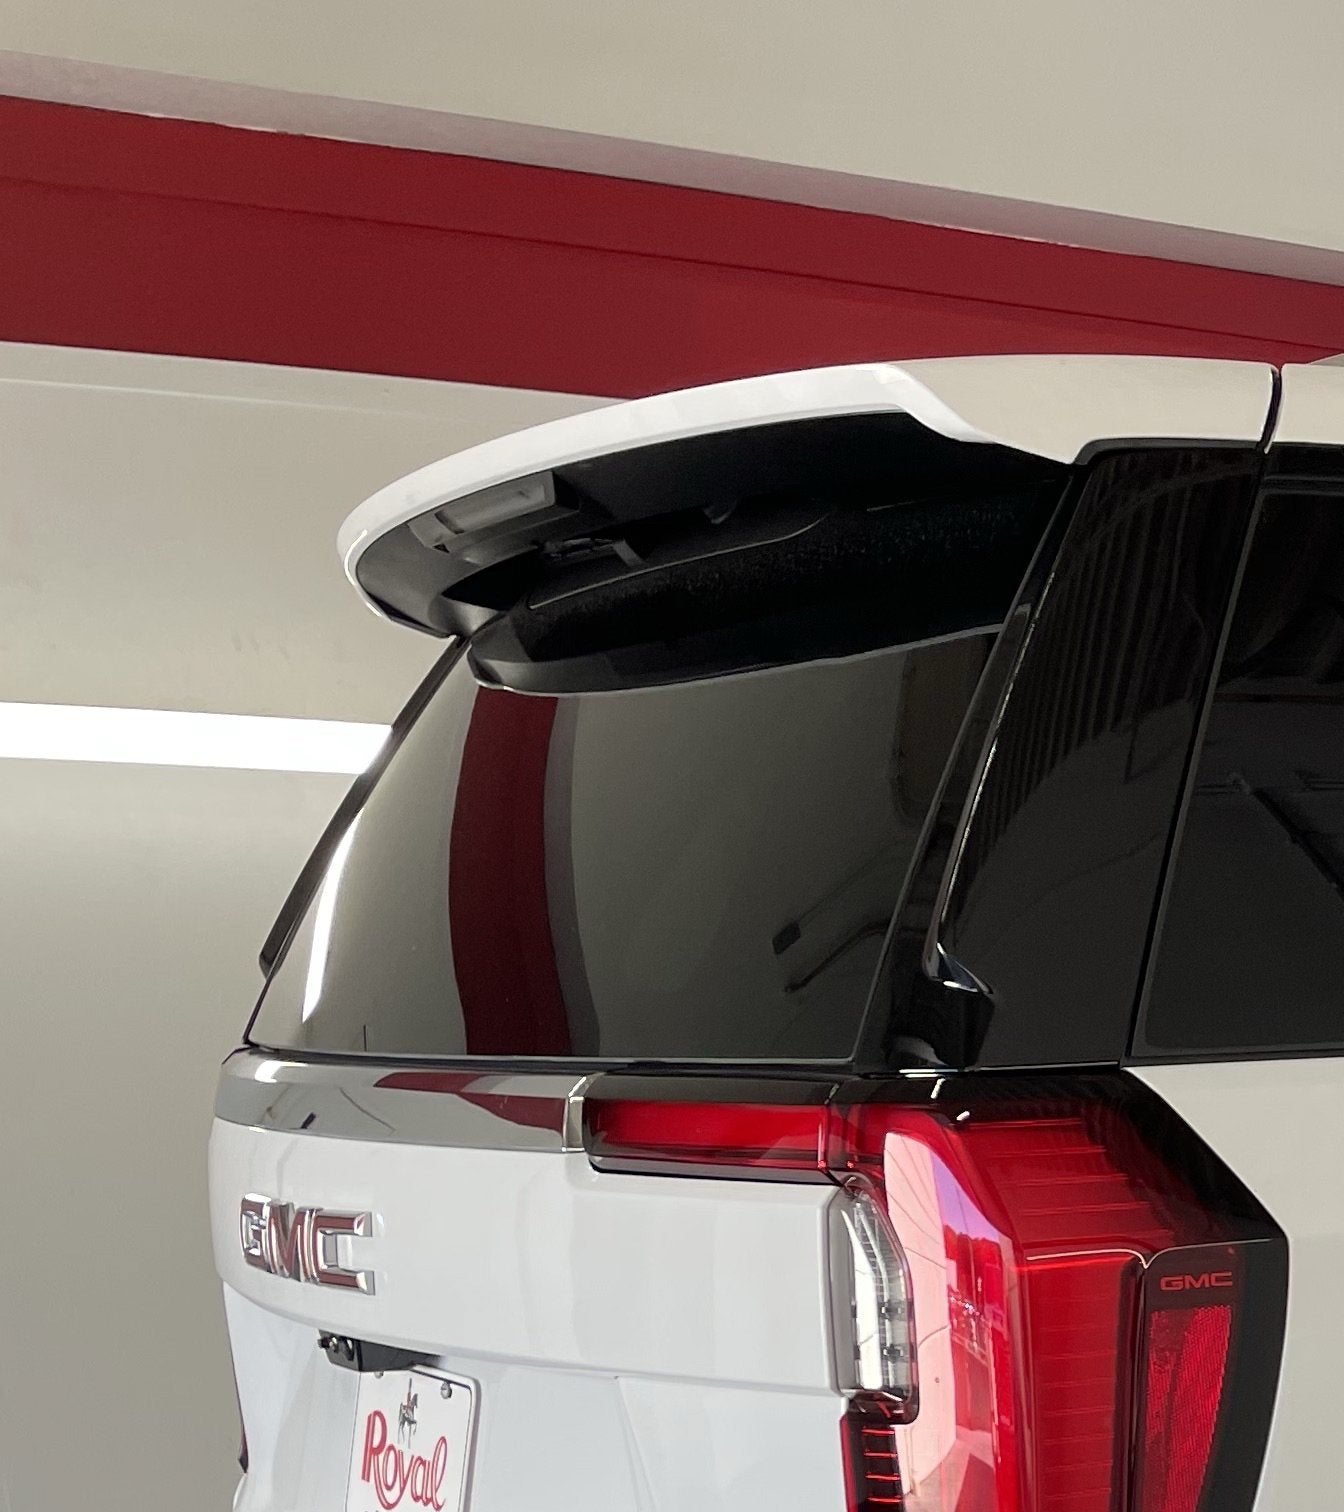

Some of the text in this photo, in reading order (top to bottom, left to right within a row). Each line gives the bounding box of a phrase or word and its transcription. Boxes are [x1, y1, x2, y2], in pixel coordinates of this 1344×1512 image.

[239, 1192, 376, 1296] GMC
[1160, 1271, 1233, 1291] GMC
[361, 1410, 448, 1512] Royal
